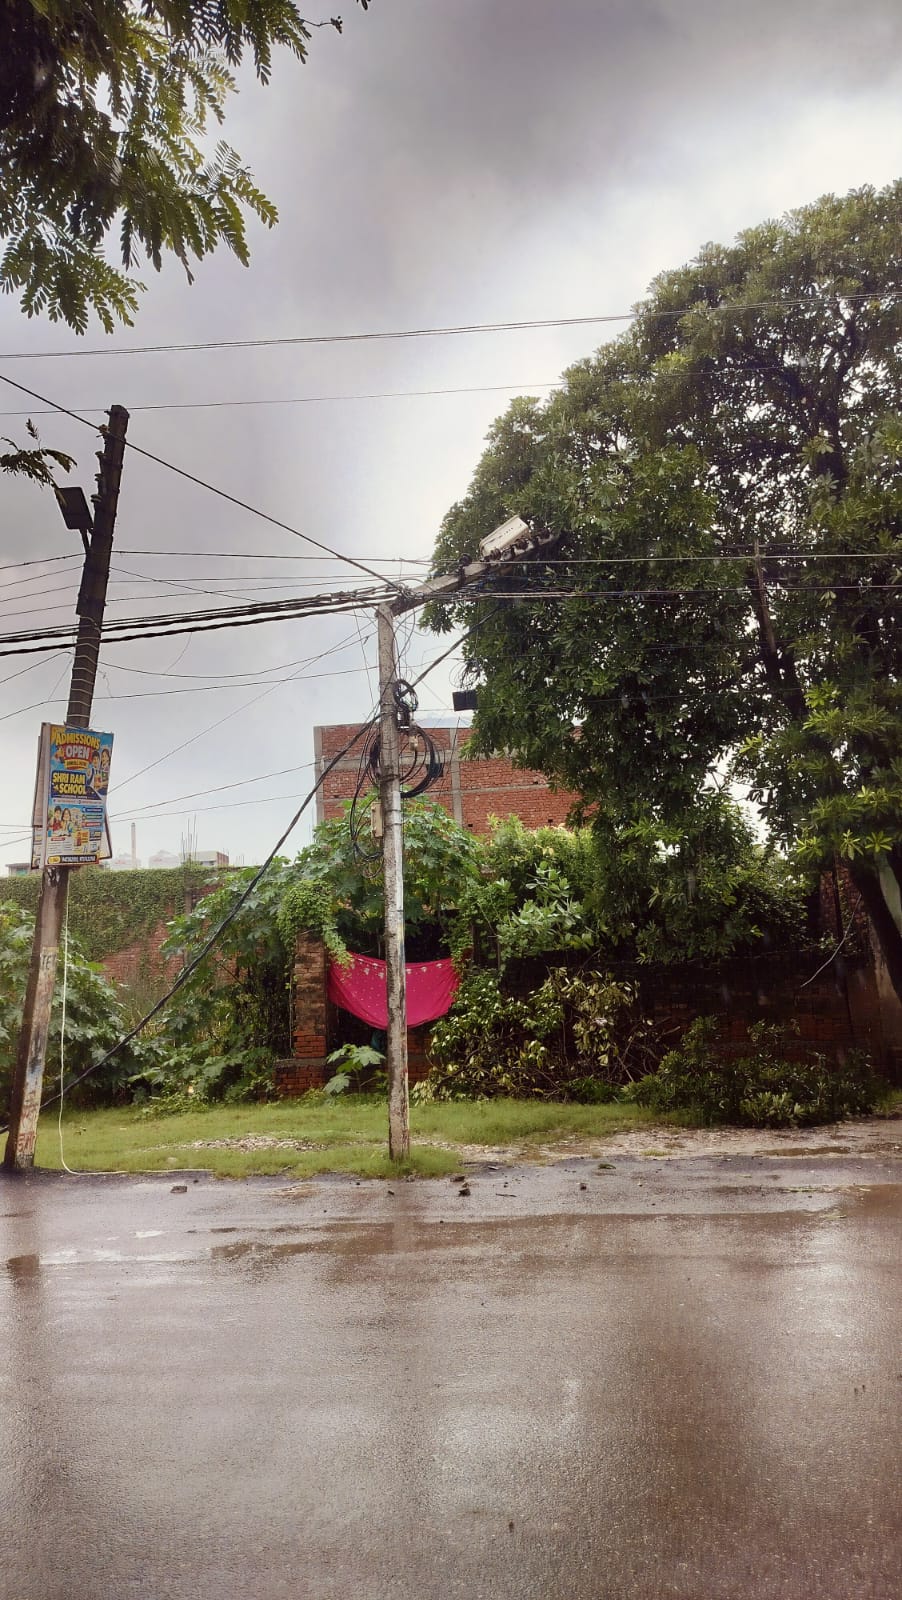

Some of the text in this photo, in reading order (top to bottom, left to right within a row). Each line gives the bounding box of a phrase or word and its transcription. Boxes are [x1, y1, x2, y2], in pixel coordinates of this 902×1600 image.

[55, 733, 100, 749] ADMISSIONS
[66, 745, 90, 759] OPEN
[53, 772, 85, 785] SHRI RAM
[59, 784, 86, 794] SCHOOL
